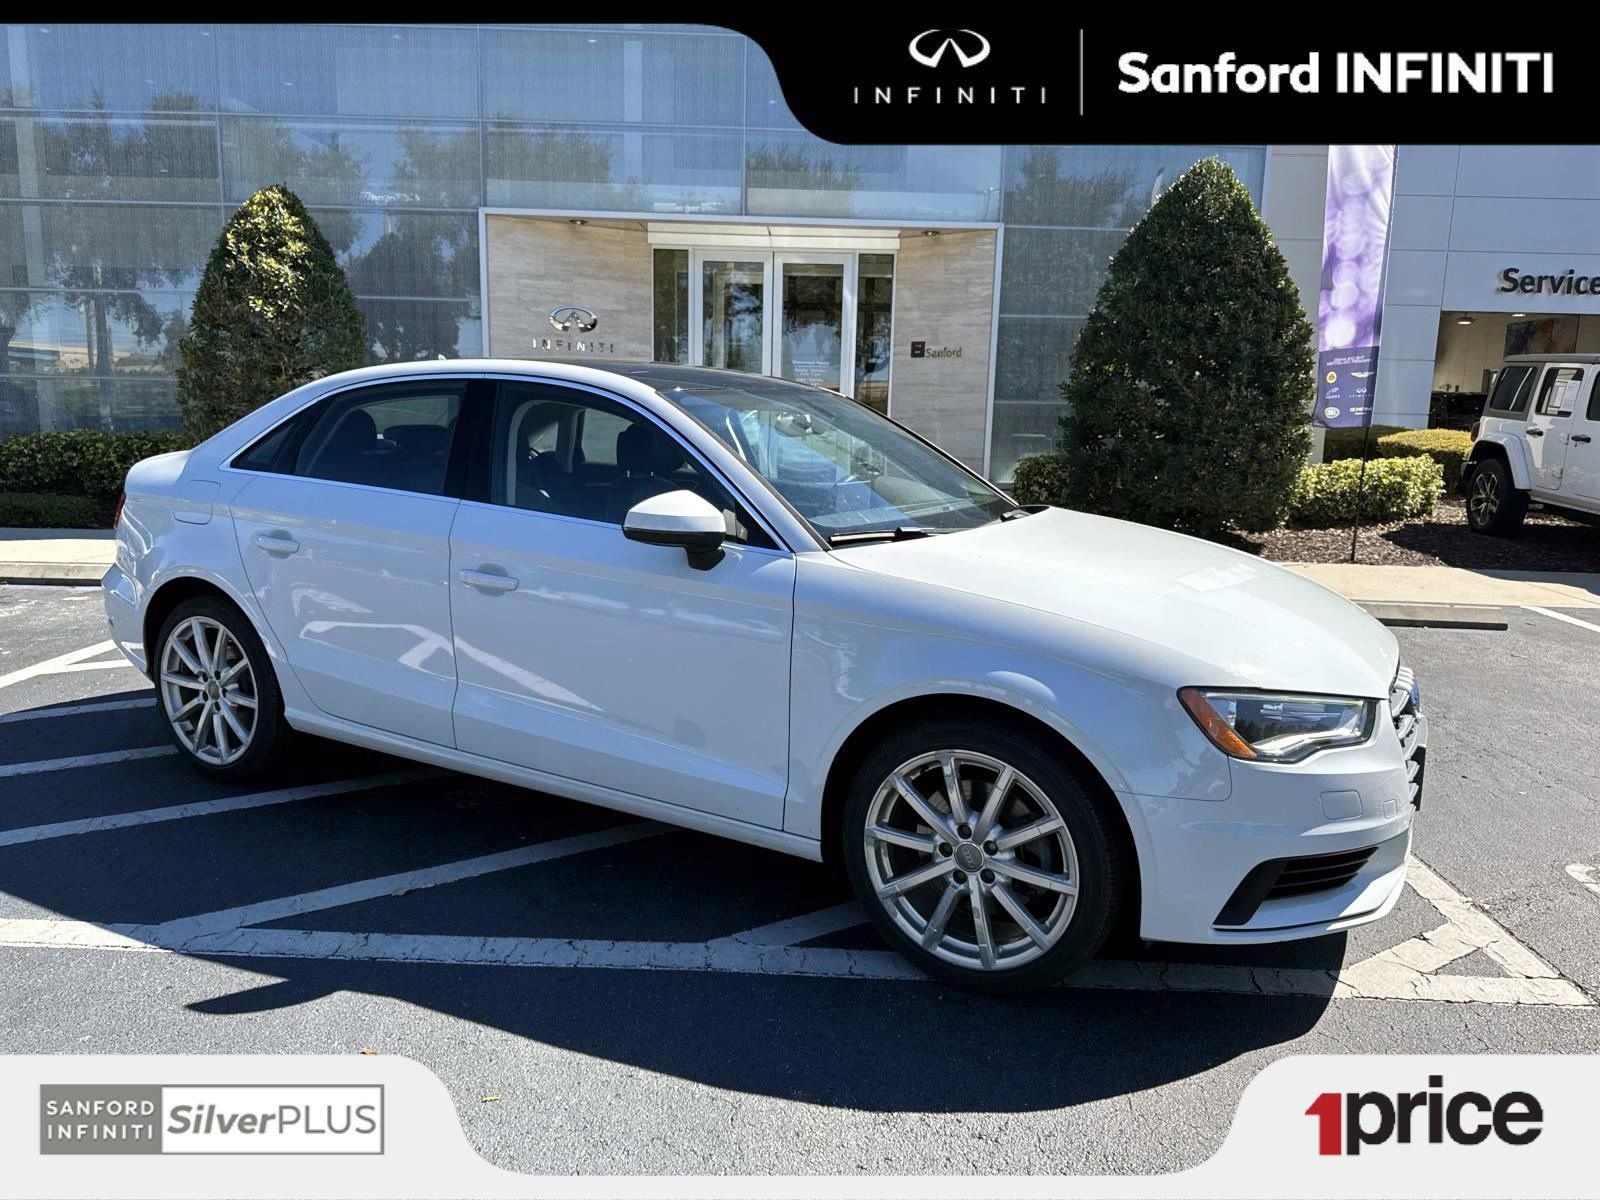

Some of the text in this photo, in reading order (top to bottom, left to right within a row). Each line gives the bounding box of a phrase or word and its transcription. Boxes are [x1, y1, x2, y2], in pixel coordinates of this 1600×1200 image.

[1500, 267, 1600, 295] Service
[532, 337, 614, 353] INFINITI
[926, 346, 962, 358] Sanford
